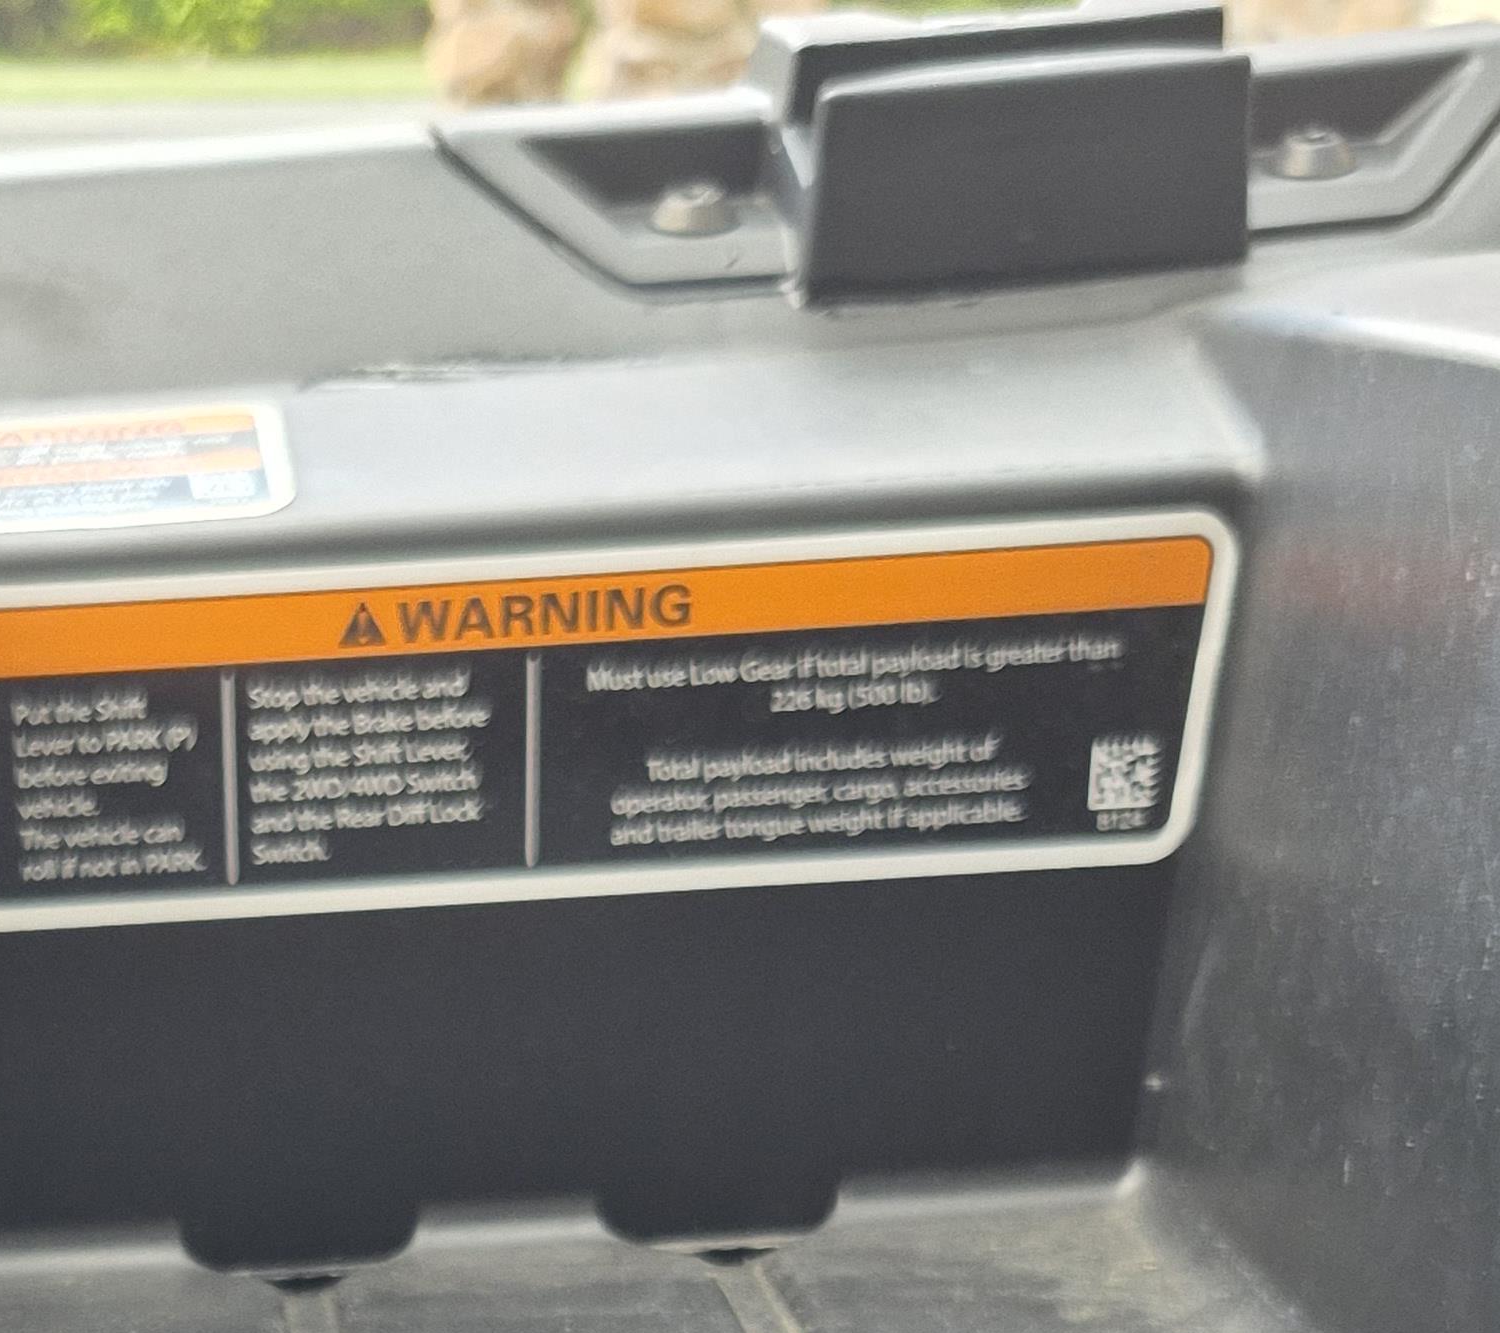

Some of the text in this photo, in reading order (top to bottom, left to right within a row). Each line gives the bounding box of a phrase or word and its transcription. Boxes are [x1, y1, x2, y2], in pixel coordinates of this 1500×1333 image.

[397, 584, 692, 644] WARNING
[587, 665, 645, 692] Must
[646, 668, 690, 689] use
[690, 660, 739, 686] Low
[740, 655, 796, 682] Gear
[816, 650, 867, 677] total
[871, 645, 961, 679] payload
[964, 645, 984, 669] is
[985, 642, 1066, 672] greater
[1067, 638, 1122, 661] than
[248, 674, 469, 712] Stop the vehicle and
[12, 693, 148, 726] Put the Shift
[249, 706, 491, 745] apply the Brake before
[14, 733, 75, 757] Lever
[77, 731, 103, 754] to
[106, 727, 163, 752] PARK
[249, 753, 311, 775] using
[313, 747, 351, 768] the
[352, 743, 404, 766] Shift
[647, 734, 1000, 783] Total payload includes weight of
[15, 762, 168, 789] before exiting
[251, 783, 289, 803] the
[405, 773, 481, 795] Switch
[251, 813, 297, 834] and
[297, 810, 335, 831] the
[336, 808, 386, 829] Rear
[387, 802, 430, 826] Diff
[611, 820, 655, 846] and
[656, 817, 724, 843] trailer
[724, 814, 807, 842] tongue
[807, 808, 888, 836] weight
[20, 822, 185, 850] The vehicle can
[22, 858, 58, 881] roll
[61, 855, 78, 879] if
[79, 856, 116, 878] not
[119, 856, 142, 876] in
